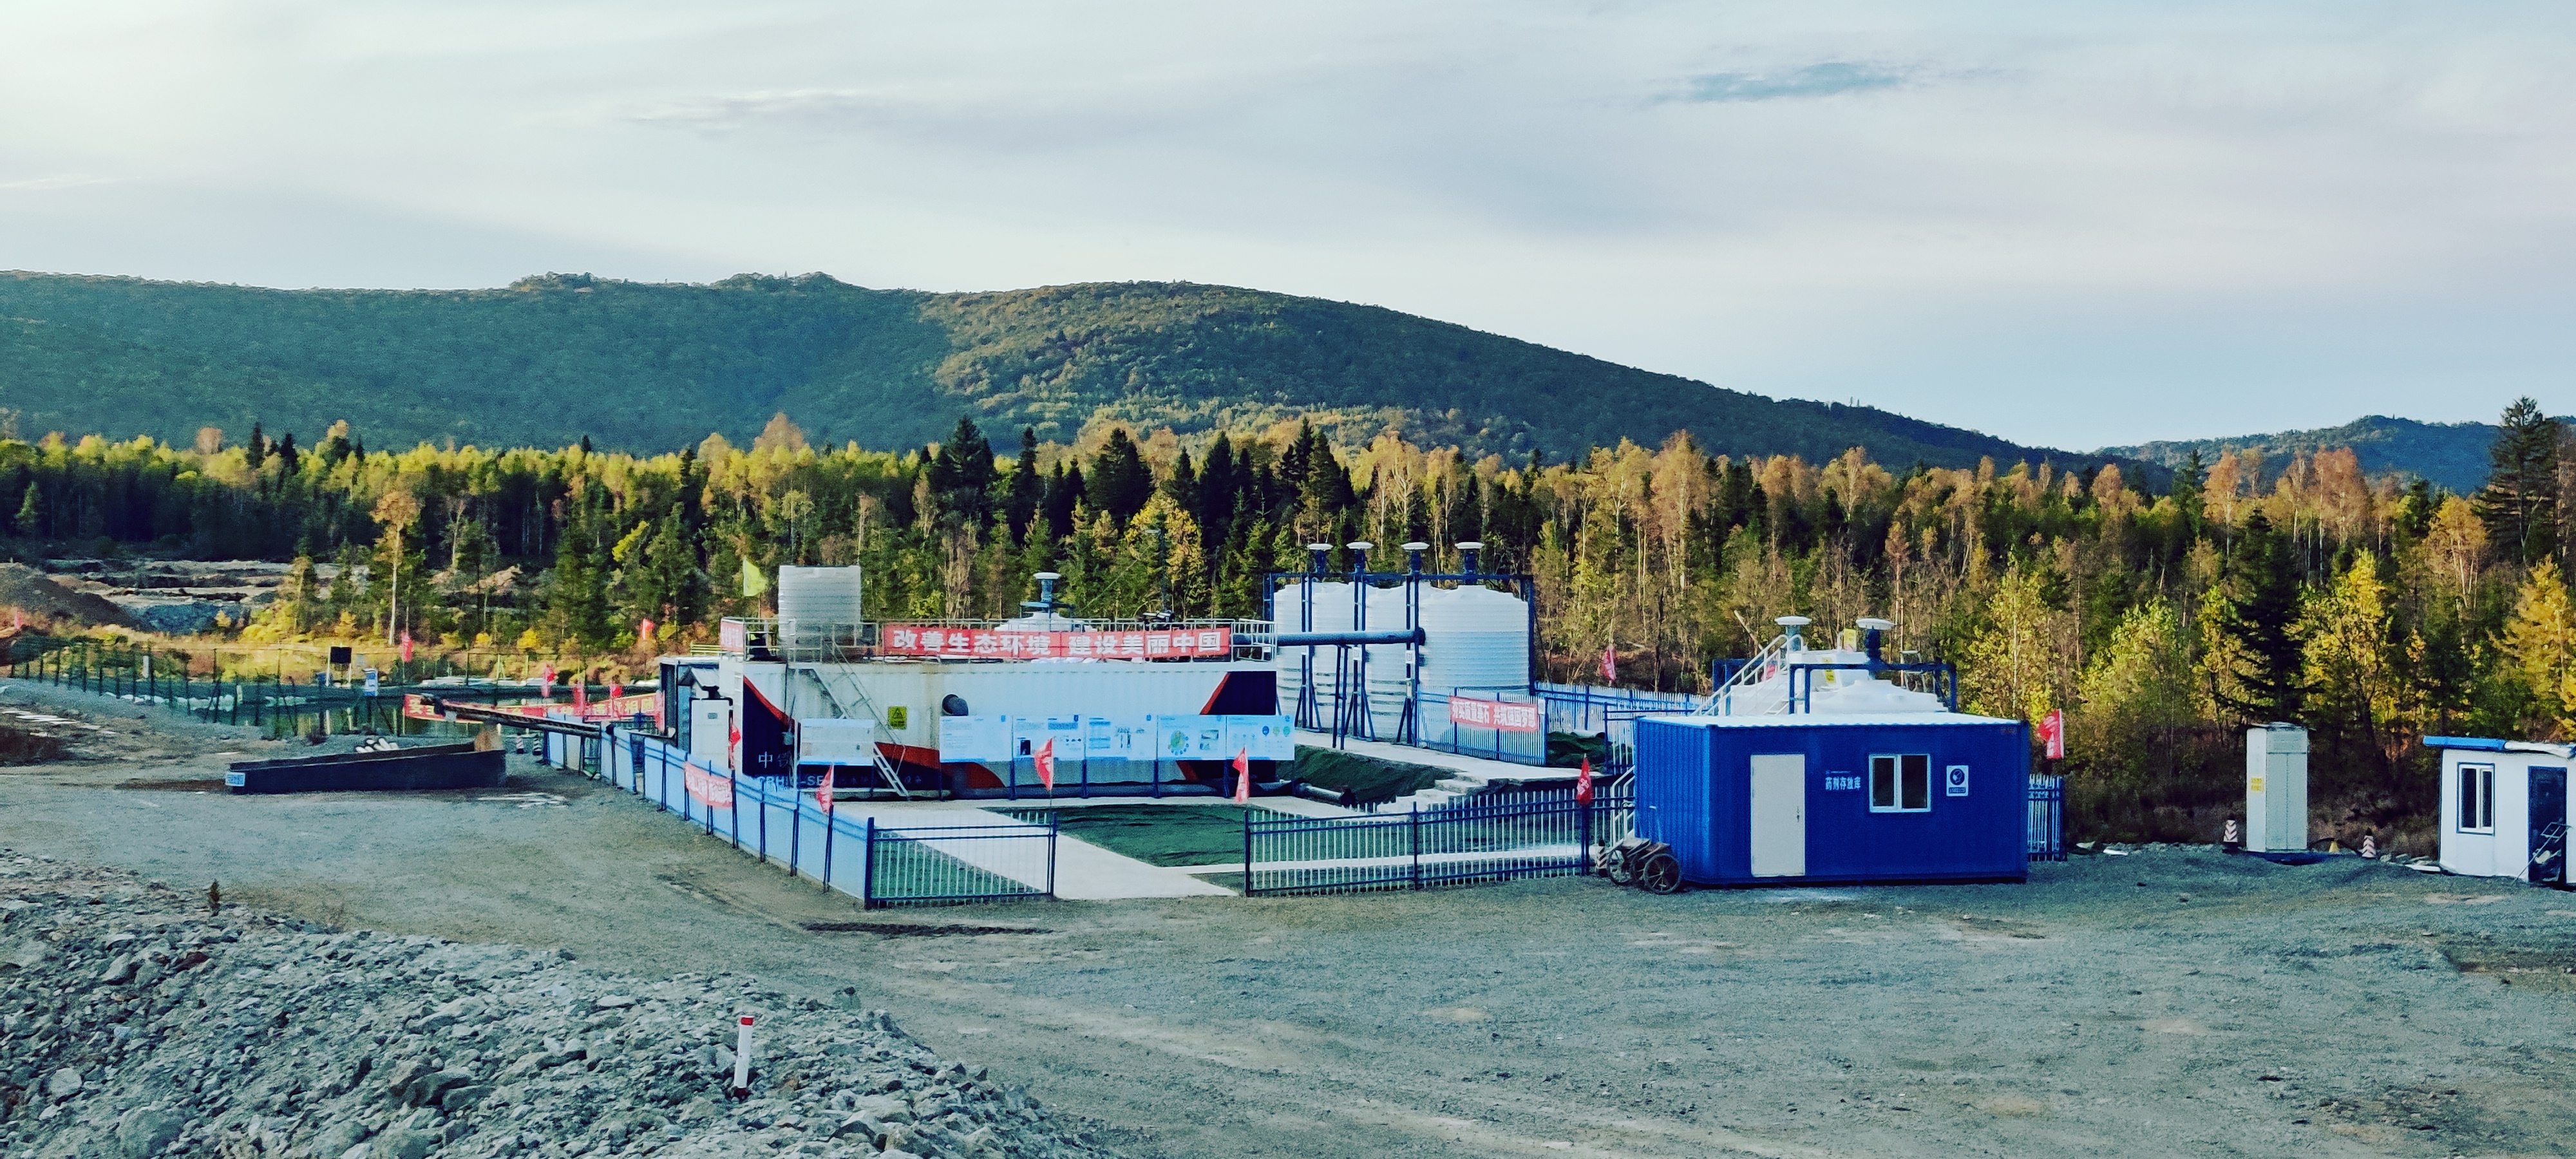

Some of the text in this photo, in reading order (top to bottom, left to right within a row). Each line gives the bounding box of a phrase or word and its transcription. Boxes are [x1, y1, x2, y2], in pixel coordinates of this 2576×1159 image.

[894, 630, 1220, 655] 改善生态环境 建设美丽中国
